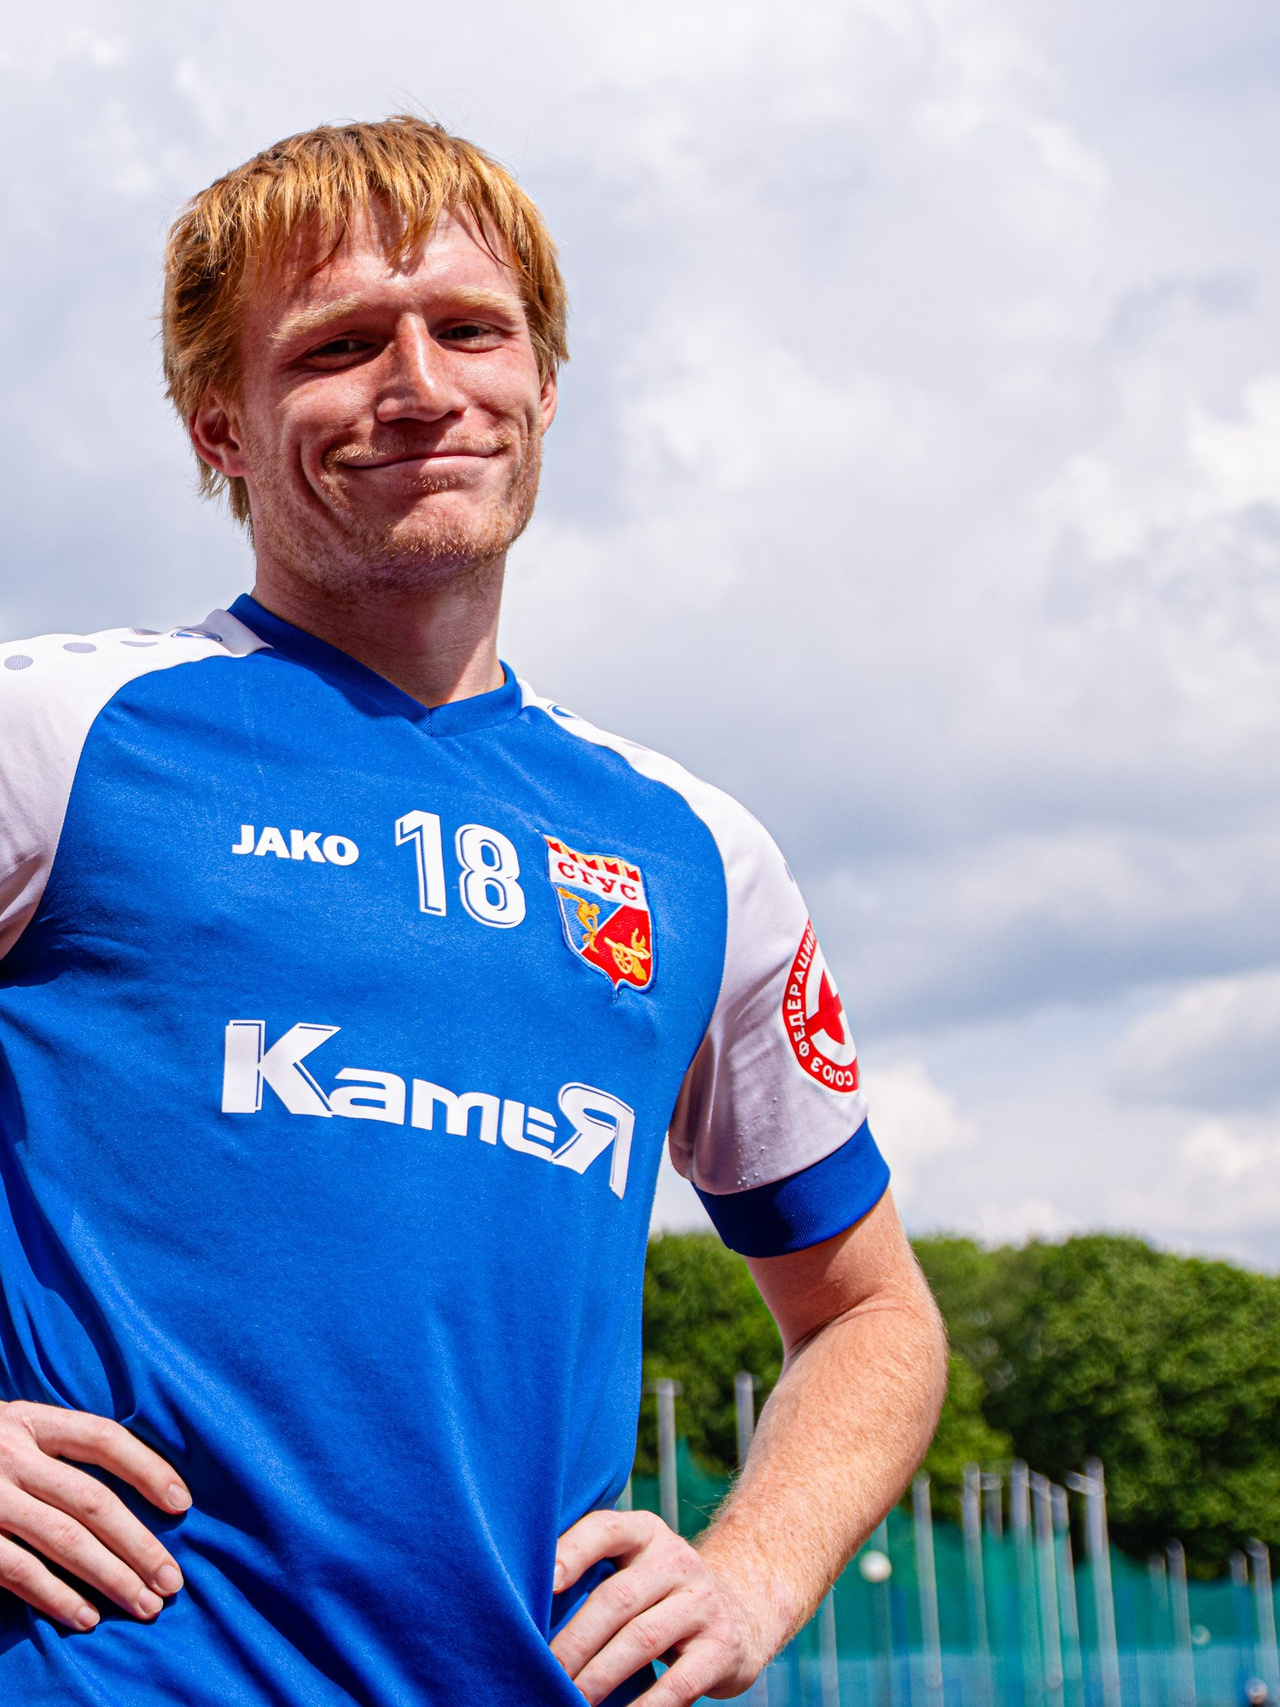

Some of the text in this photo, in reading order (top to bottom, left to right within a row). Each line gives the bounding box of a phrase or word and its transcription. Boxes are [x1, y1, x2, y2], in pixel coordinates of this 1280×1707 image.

[231, 825, 360, 866] JAKO
[395, 810, 527, 929] 18
[811, 1057, 854, 1087] СОЮЗ
